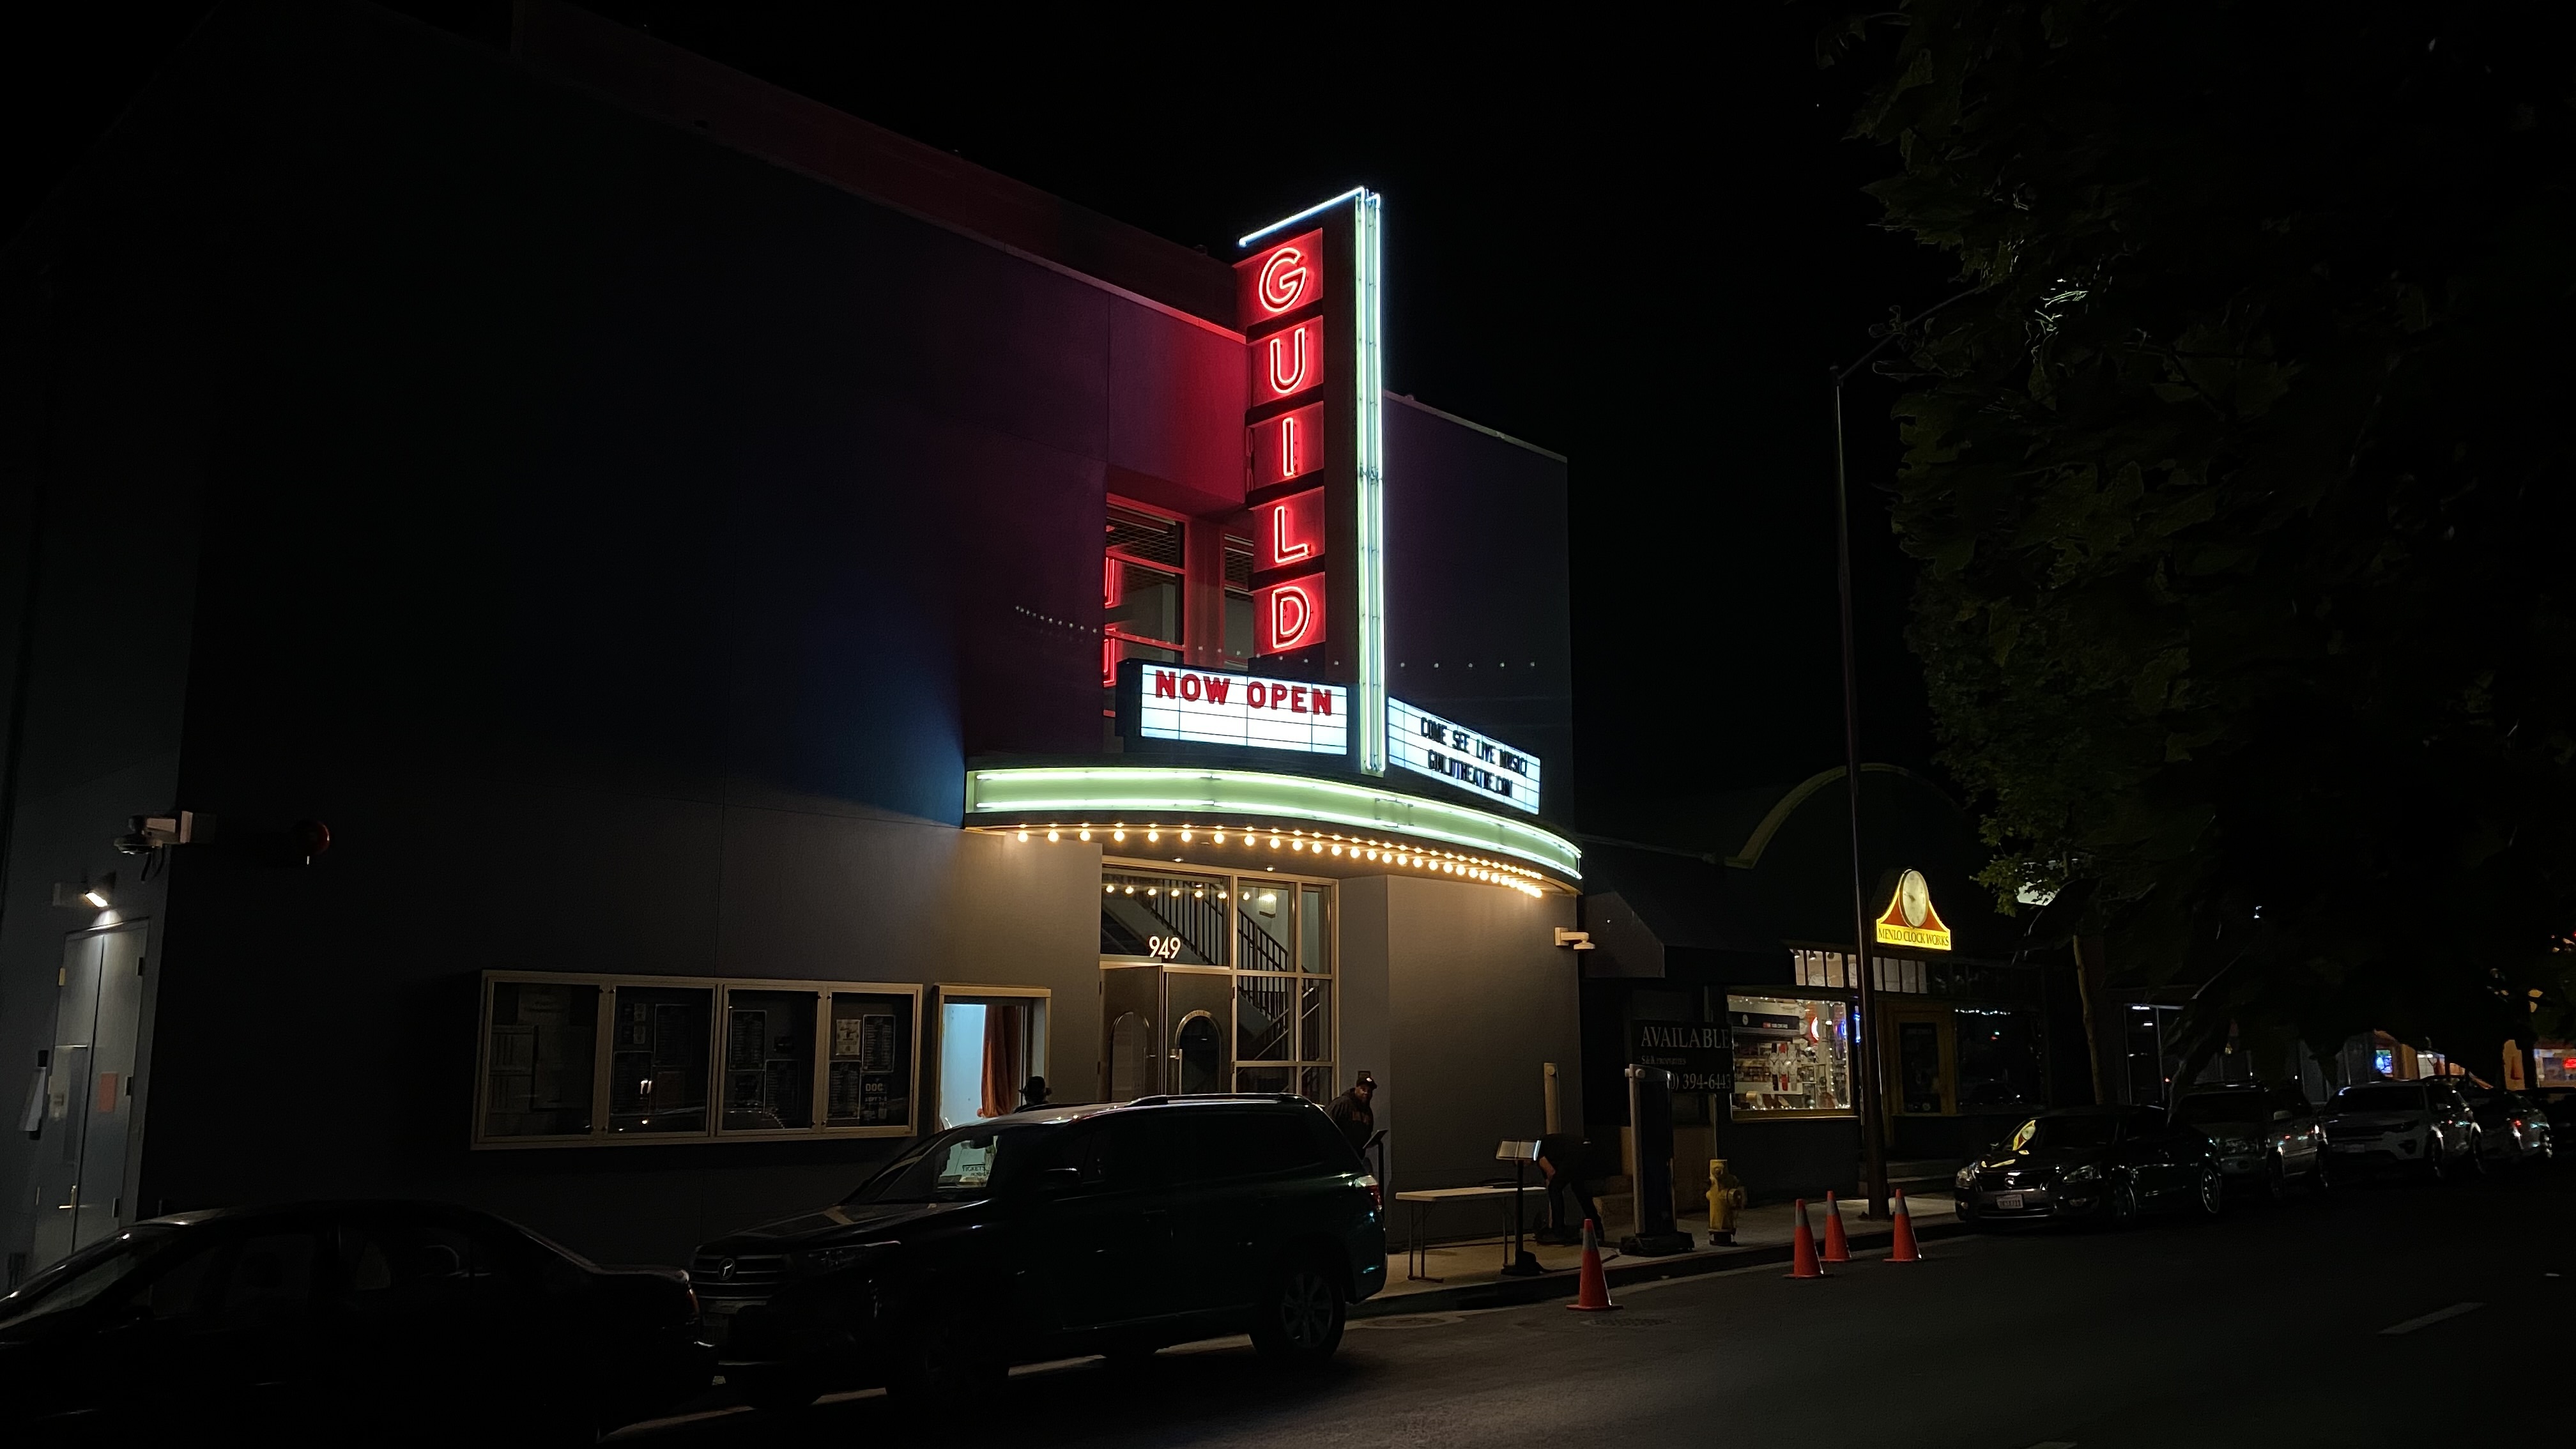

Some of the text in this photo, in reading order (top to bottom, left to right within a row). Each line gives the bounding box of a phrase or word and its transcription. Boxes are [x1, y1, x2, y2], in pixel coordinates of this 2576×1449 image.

[1259, 247, 1311, 648] GUILD
[1155, 670, 1332, 716] NOW OPEN
[1420, 716, 1448, 746] COME
[1452, 730, 1471, 754] SEE
[1476, 739, 1496, 765] LIVE
[1149, 935, 1181, 959] 949
[1878, 928, 1949, 946] MENLO CLOCK WORKS
[1641, 1025, 1730, 1049] AVAILABLE
